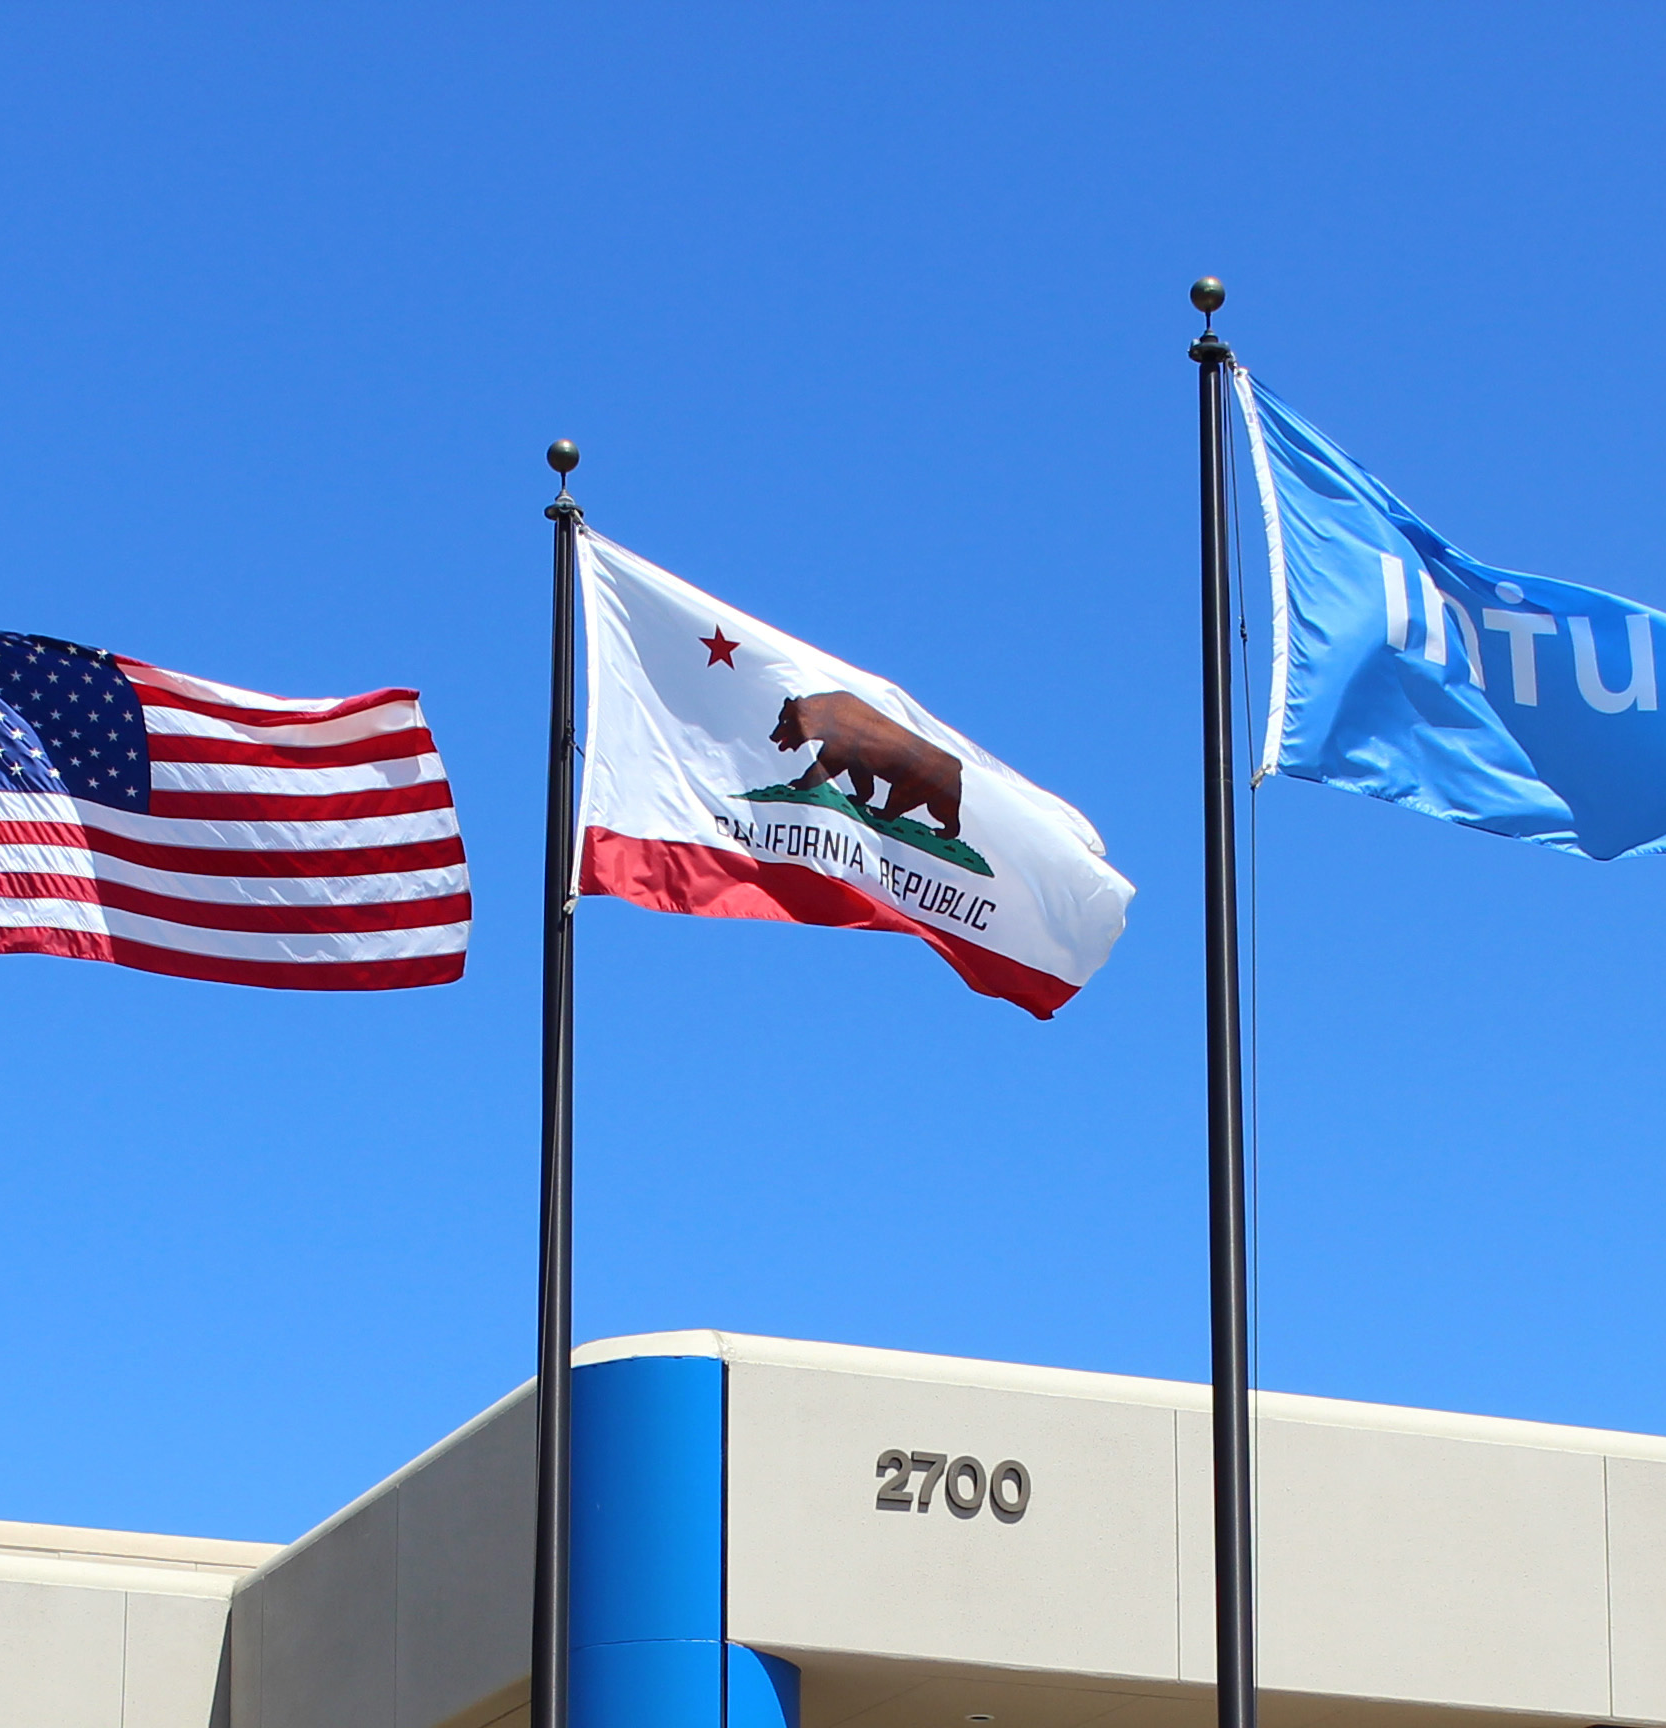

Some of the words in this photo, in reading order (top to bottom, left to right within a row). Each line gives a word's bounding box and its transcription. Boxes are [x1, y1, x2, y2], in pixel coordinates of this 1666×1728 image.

[715, 815, 864, 874] CALIFORNIA
[879, 856, 997, 931] REPUBLIC
[876, 1449, 1031, 1515] 2700
